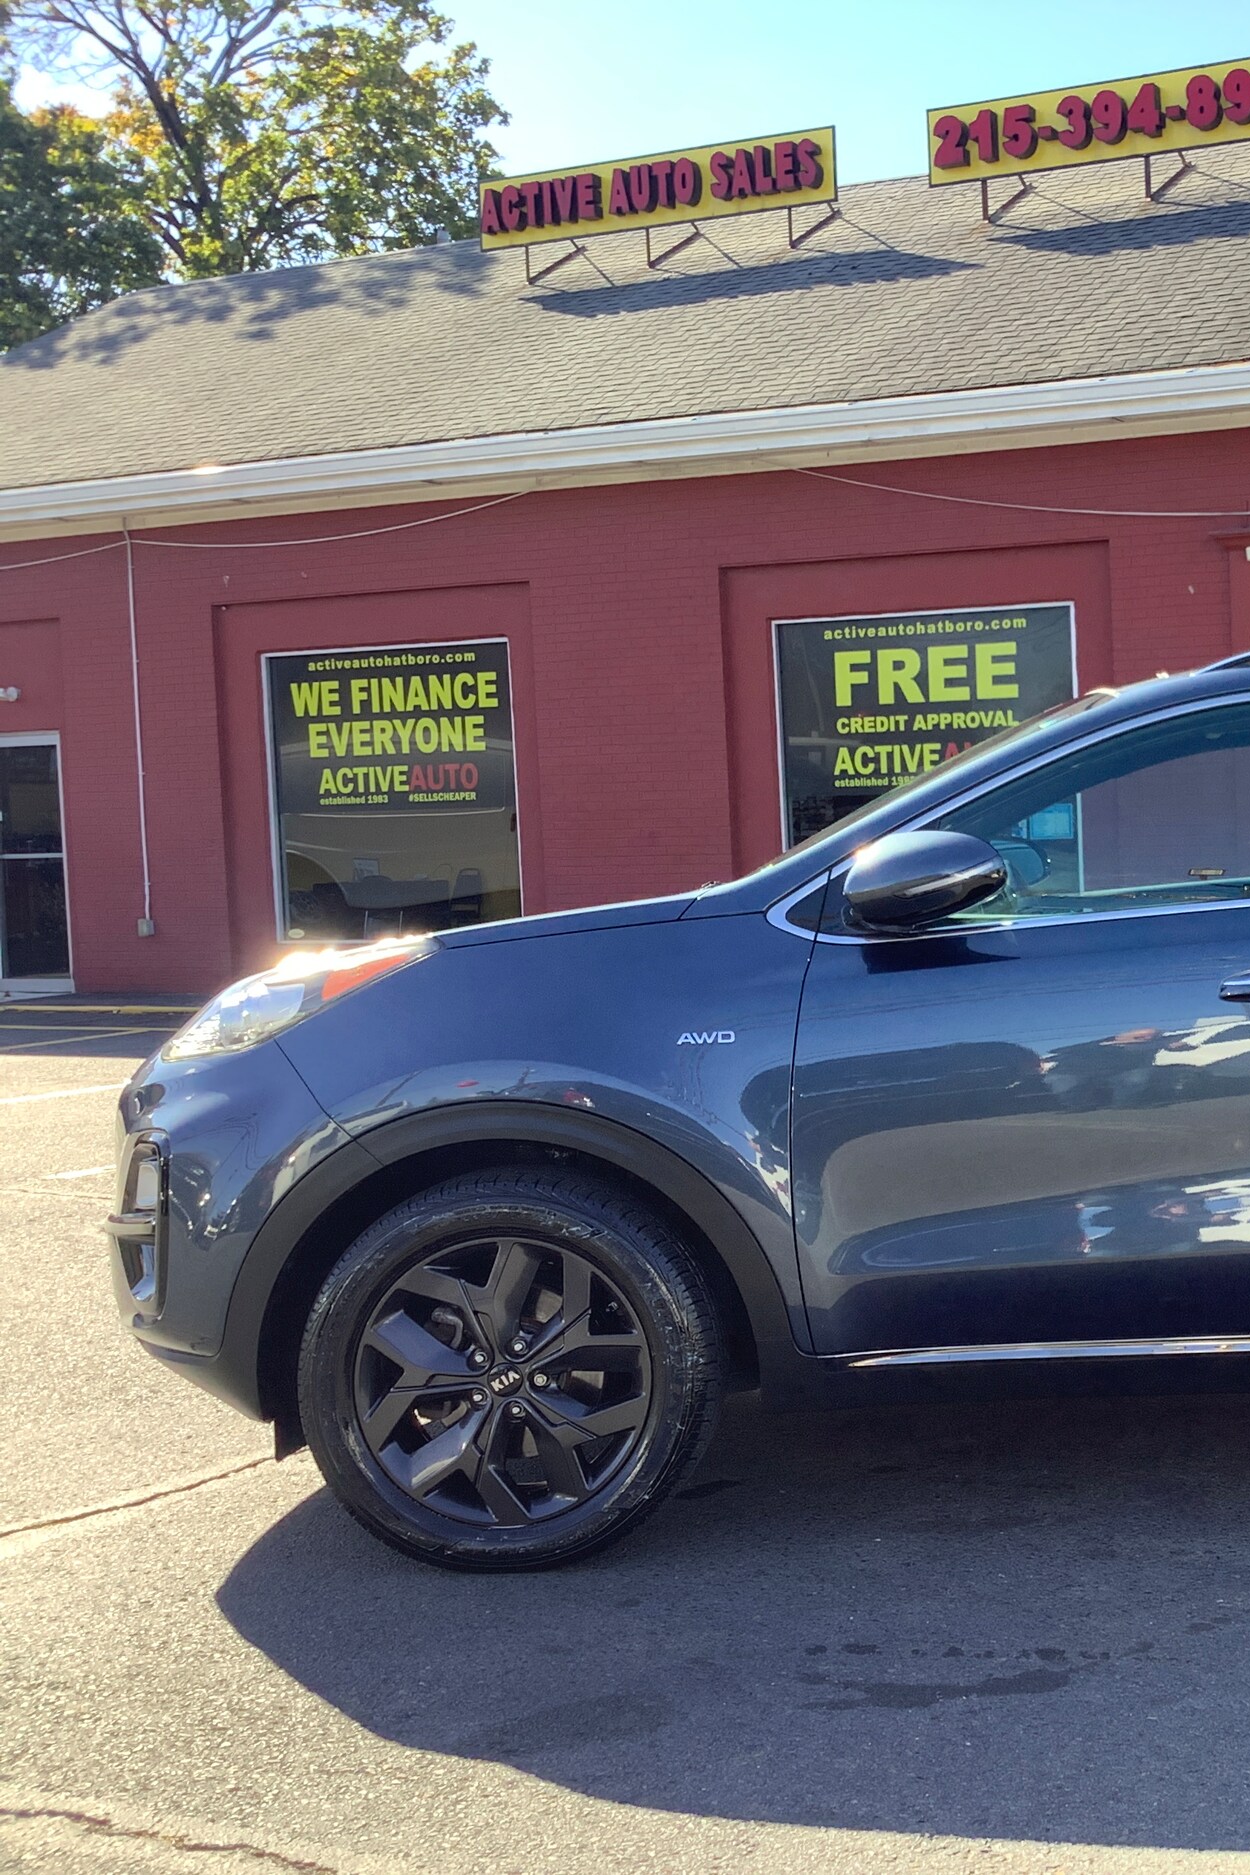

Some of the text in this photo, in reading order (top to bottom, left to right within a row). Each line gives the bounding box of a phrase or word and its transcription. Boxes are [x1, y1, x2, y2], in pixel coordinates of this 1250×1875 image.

[481, 138, 822, 236] ACTIVE AUTO SALES
[823, 616, 1027, 641] activeautohatboro.com
[308, 652, 476, 672] activeautohatboro.com
[833, 641, 1019, 707] FREE
[290, 671, 499, 718] WE FINANCE
[836, 710, 1020, 734] CREDIT APPROVAL
[308, 715, 487, 758] EVERYONE
[835, 776, 889, 787] established
[320, 795, 366, 805] established
[676, 1030, 736, 1045] AWD
[490, 1370, 520, 1392] KIA
